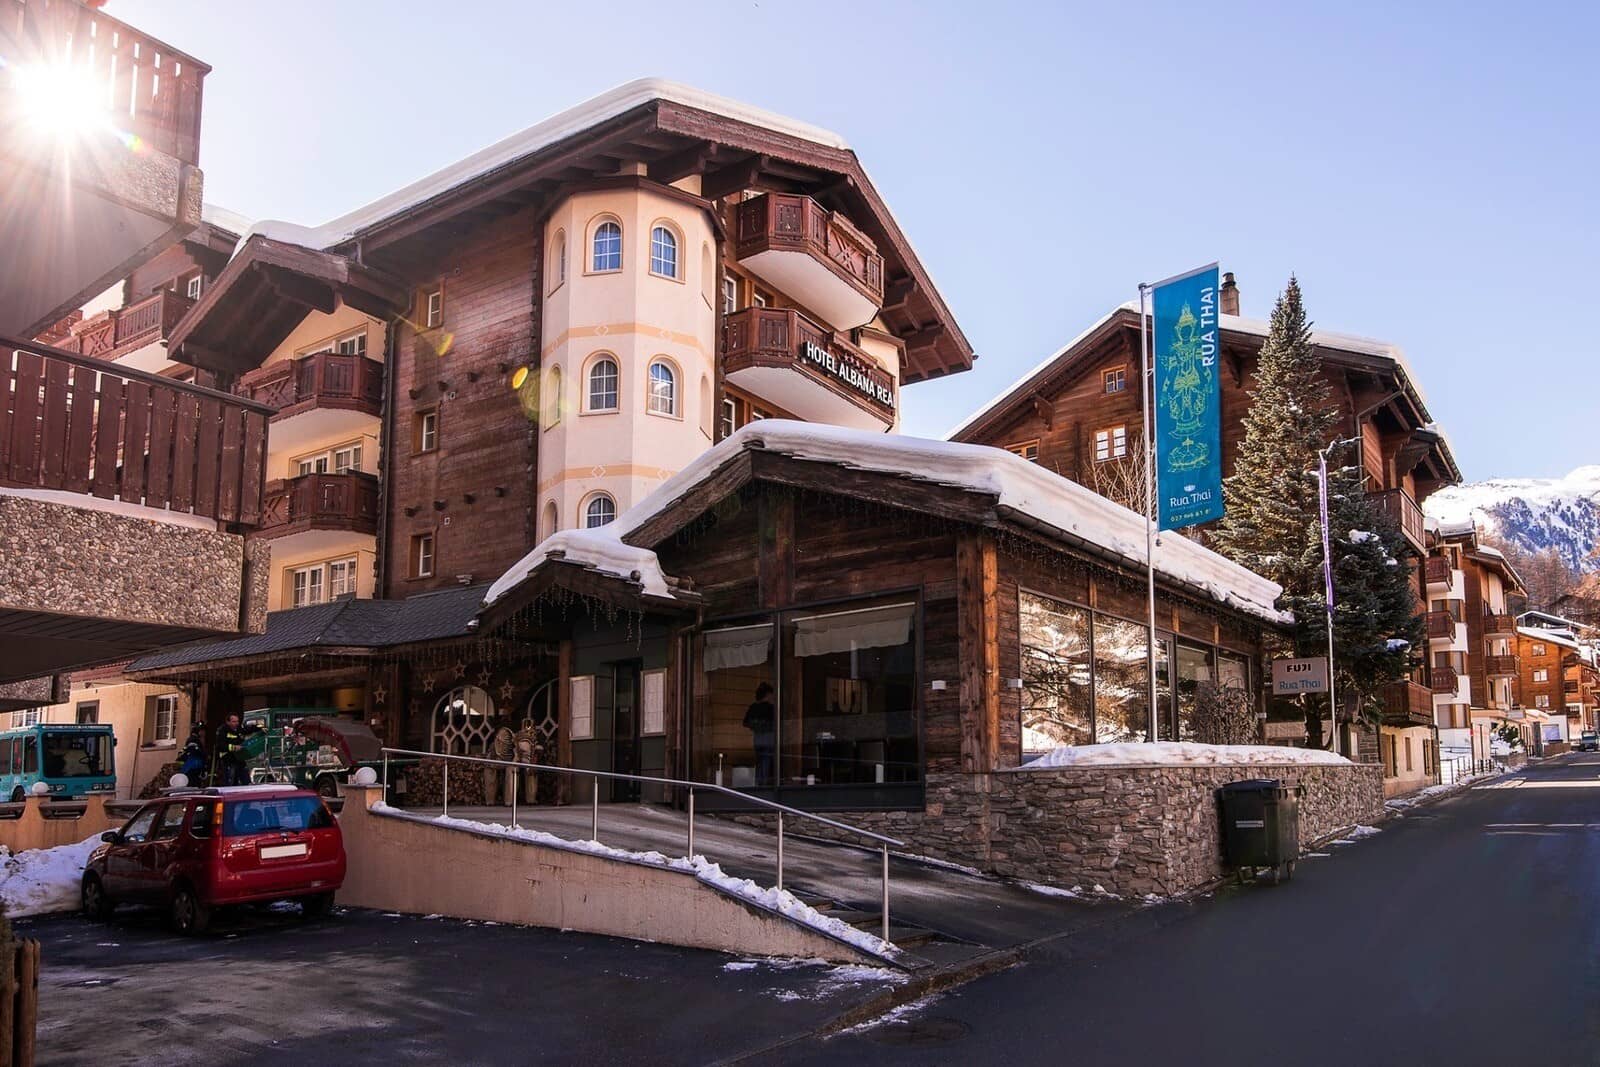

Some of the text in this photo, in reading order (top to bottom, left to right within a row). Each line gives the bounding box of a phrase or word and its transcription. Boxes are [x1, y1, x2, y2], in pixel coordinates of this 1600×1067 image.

[1201, 287, 1215, 367] RUA THAI
[807, 341, 896, 408] HOTEL ALBANA REA
[1170, 489, 1211, 508] Rua Thai
[1286, 664, 1311, 673] FUJI
[1280, 680, 1298, 689] Rua
